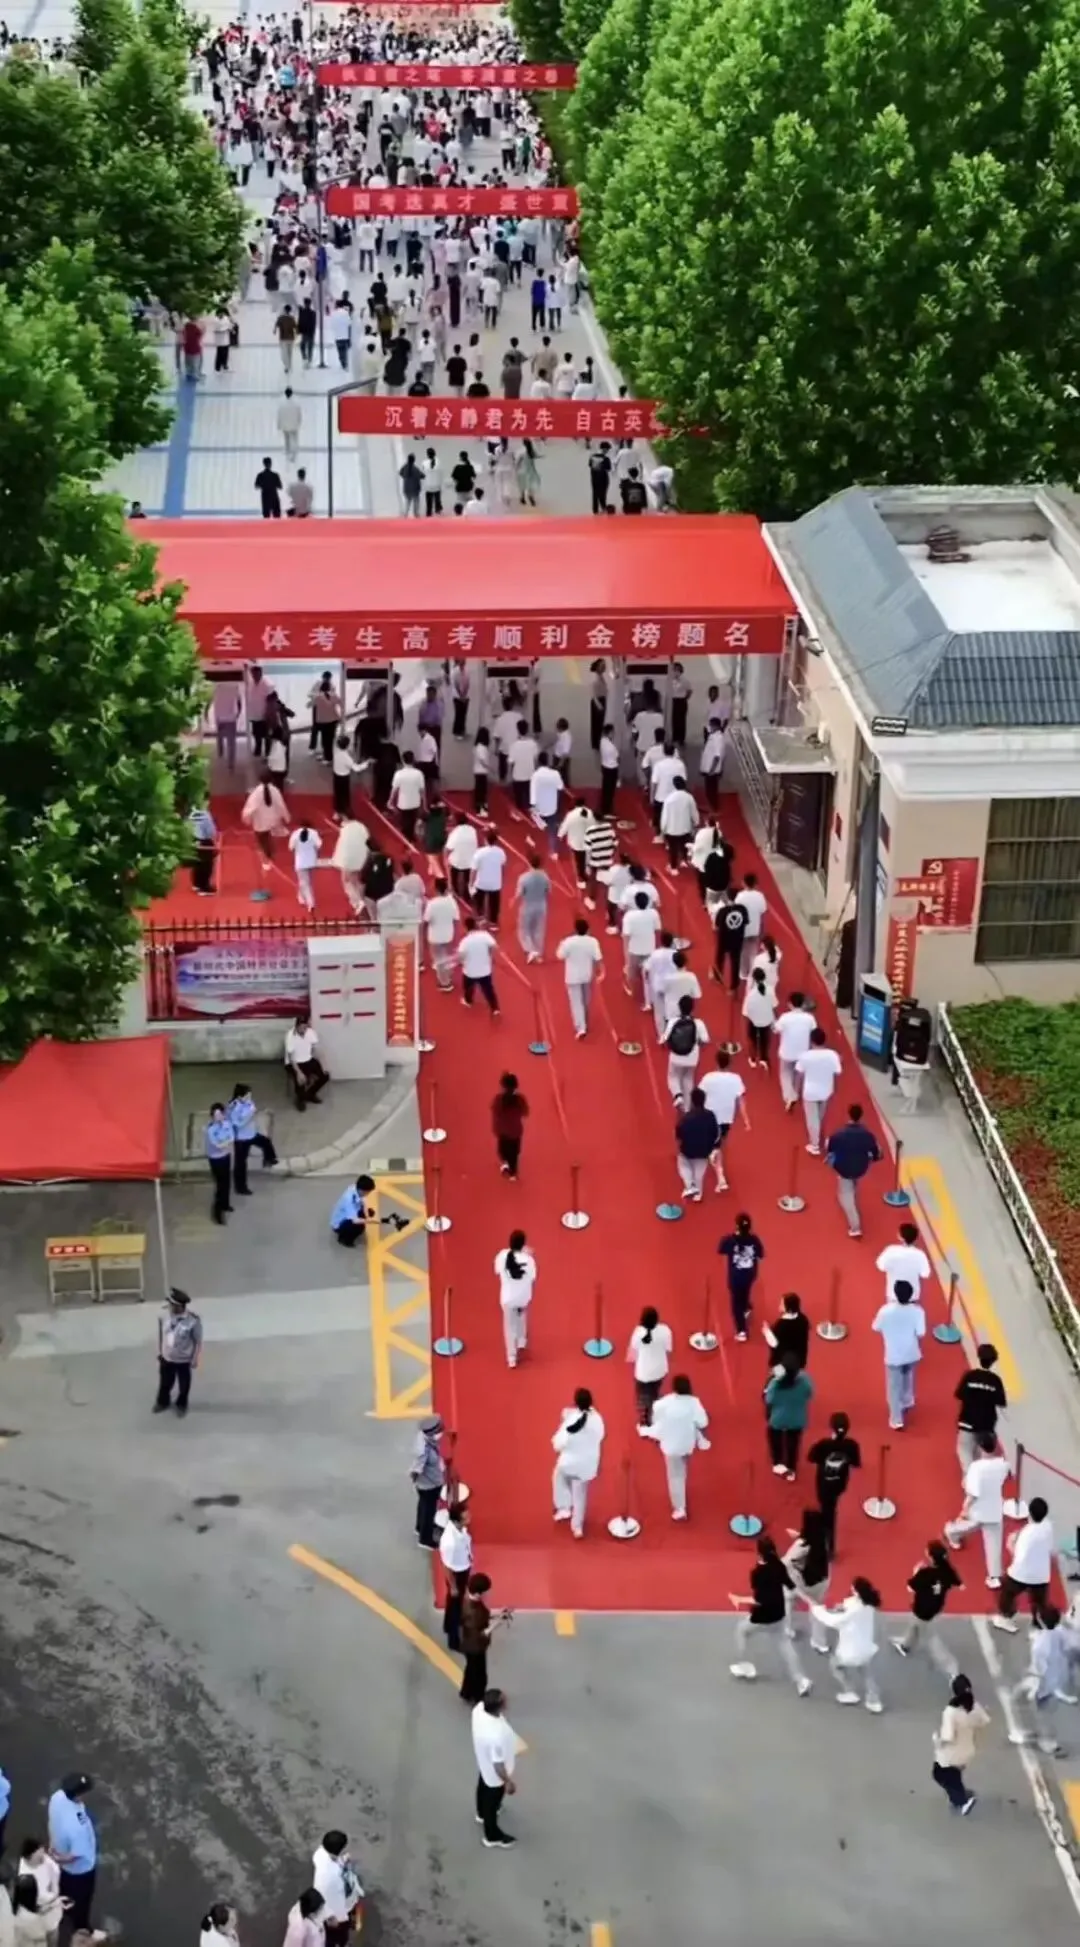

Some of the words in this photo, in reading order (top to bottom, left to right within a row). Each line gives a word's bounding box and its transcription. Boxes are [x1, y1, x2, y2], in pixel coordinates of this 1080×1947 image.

[385, 405, 554, 431] 沉着冷静君为先
